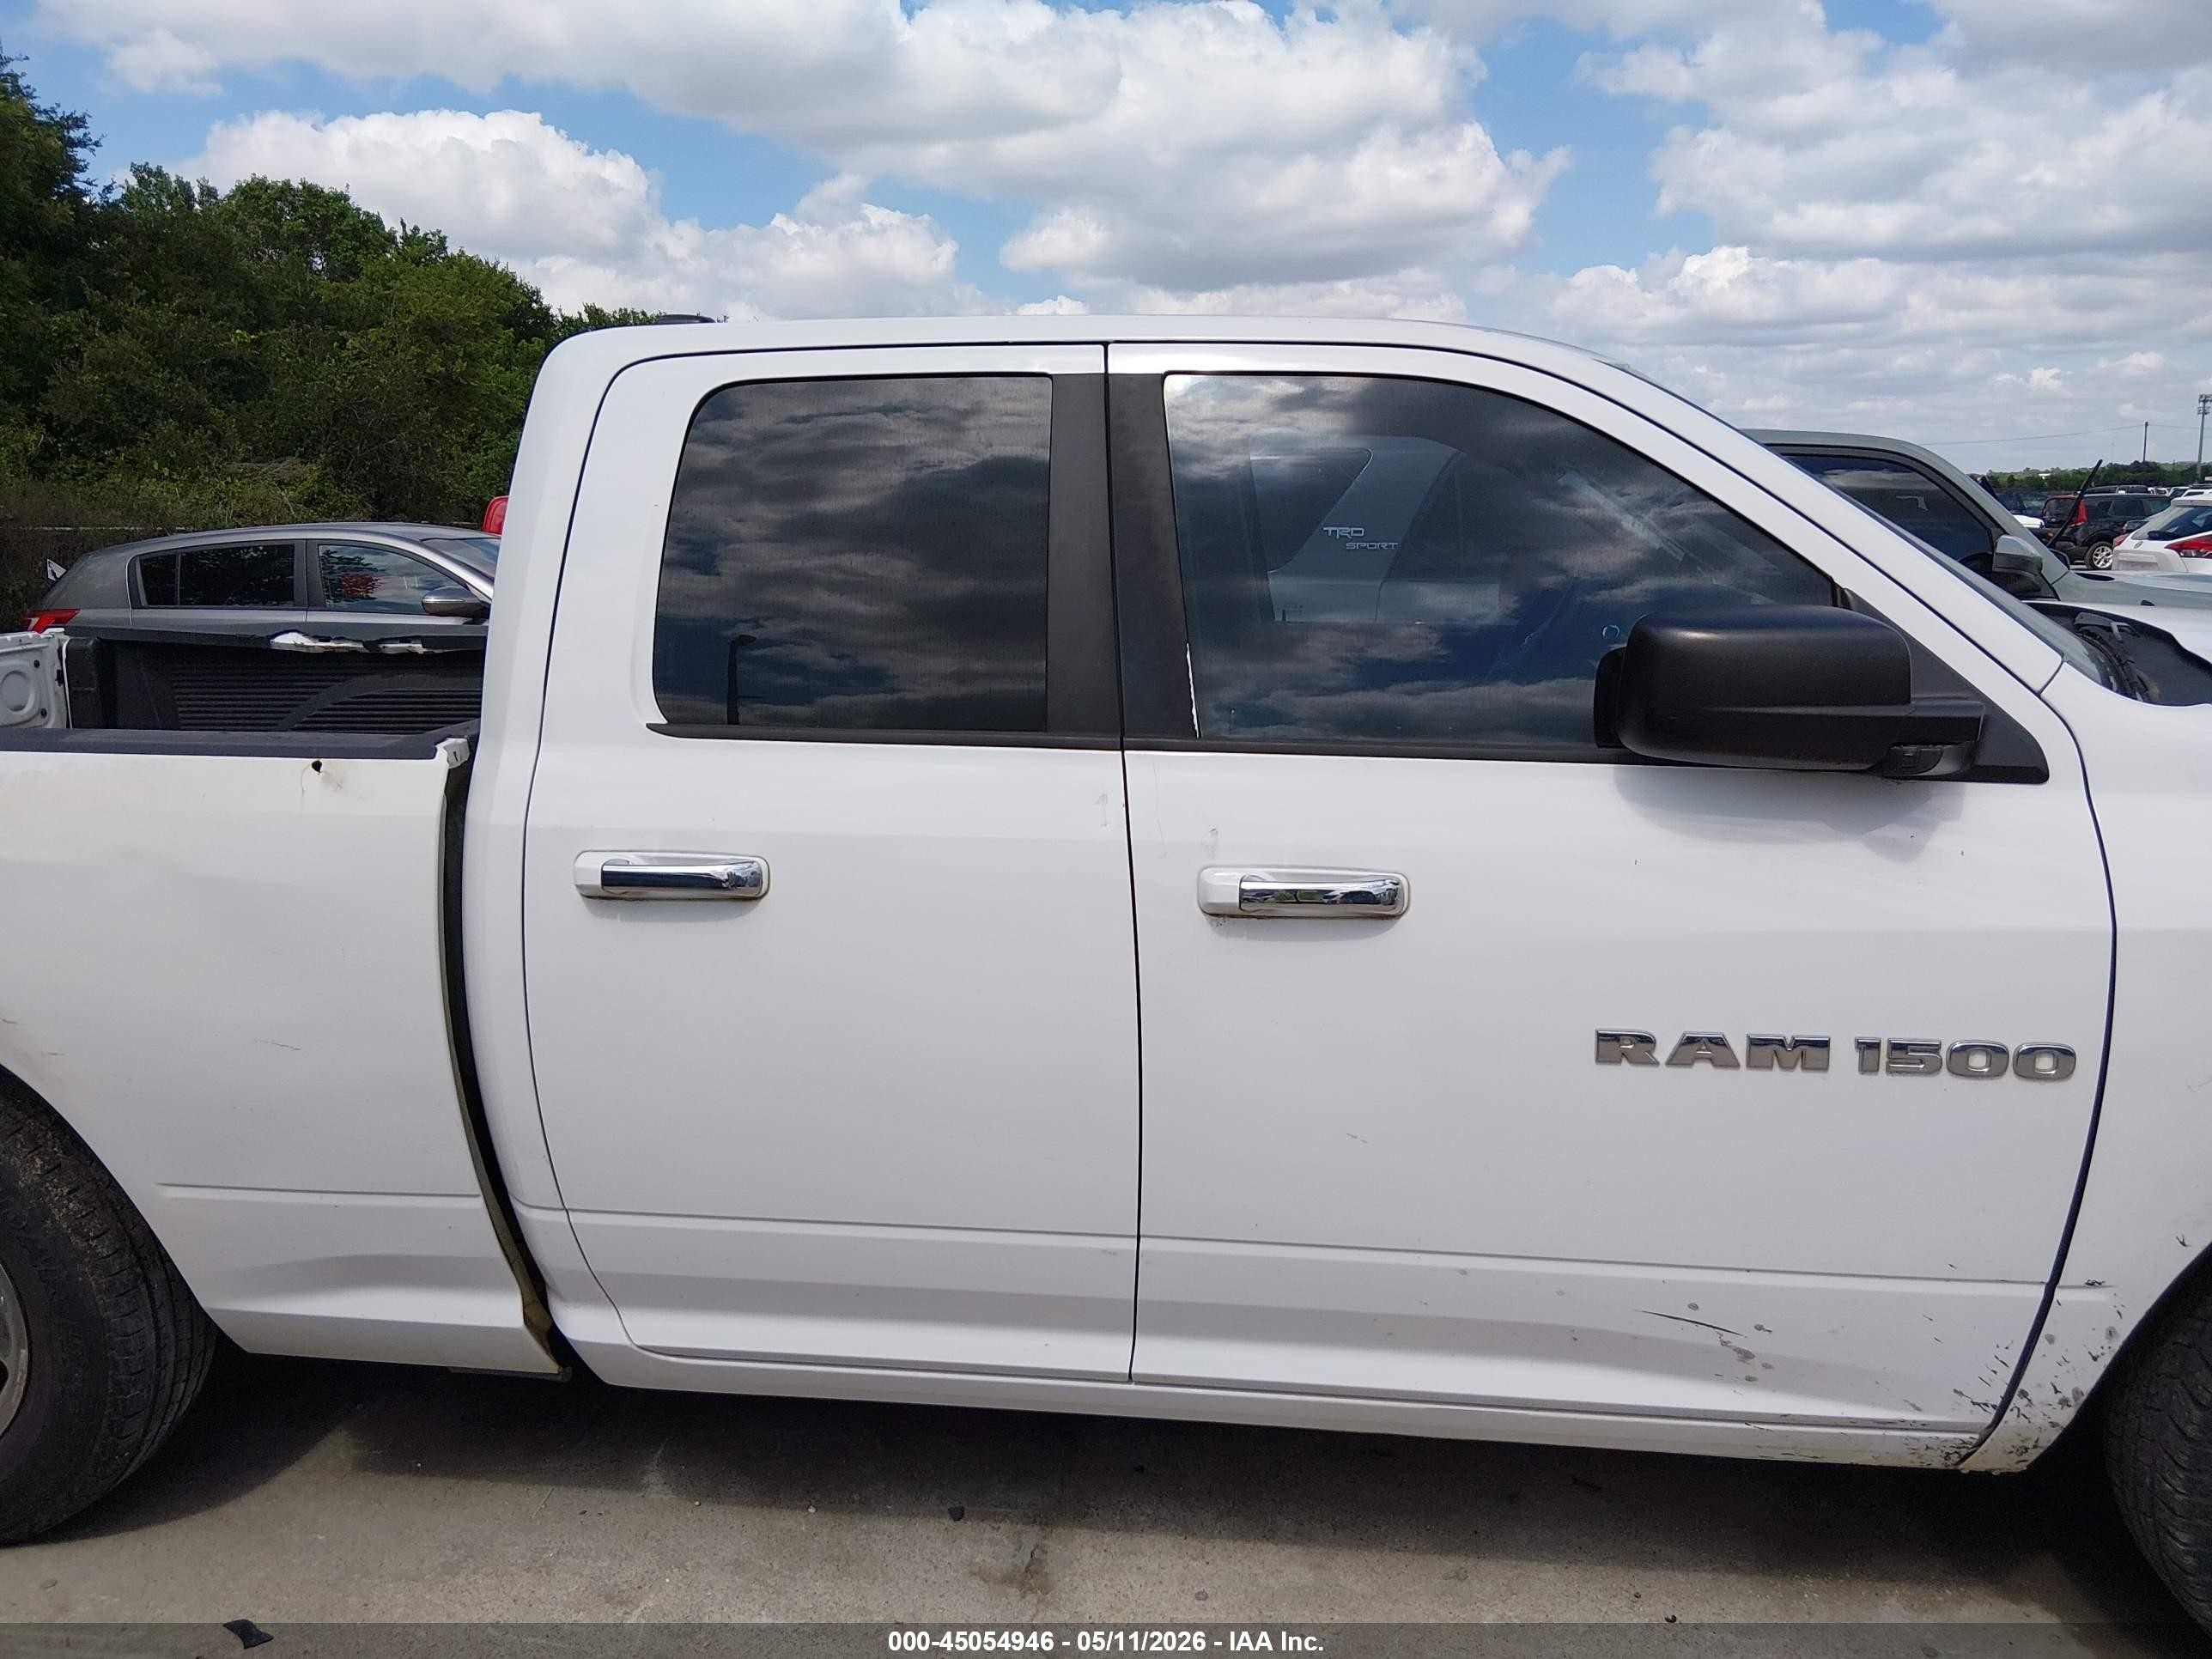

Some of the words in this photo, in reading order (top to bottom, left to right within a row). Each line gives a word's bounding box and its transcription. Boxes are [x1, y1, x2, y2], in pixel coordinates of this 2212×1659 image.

[1323, 526, 1365, 539] TRD
[1346, 542, 1400, 550] SPORT
[1595, 1030, 1831, 1072] RAM
[1854, 1036, 2077, 1080] 1500
